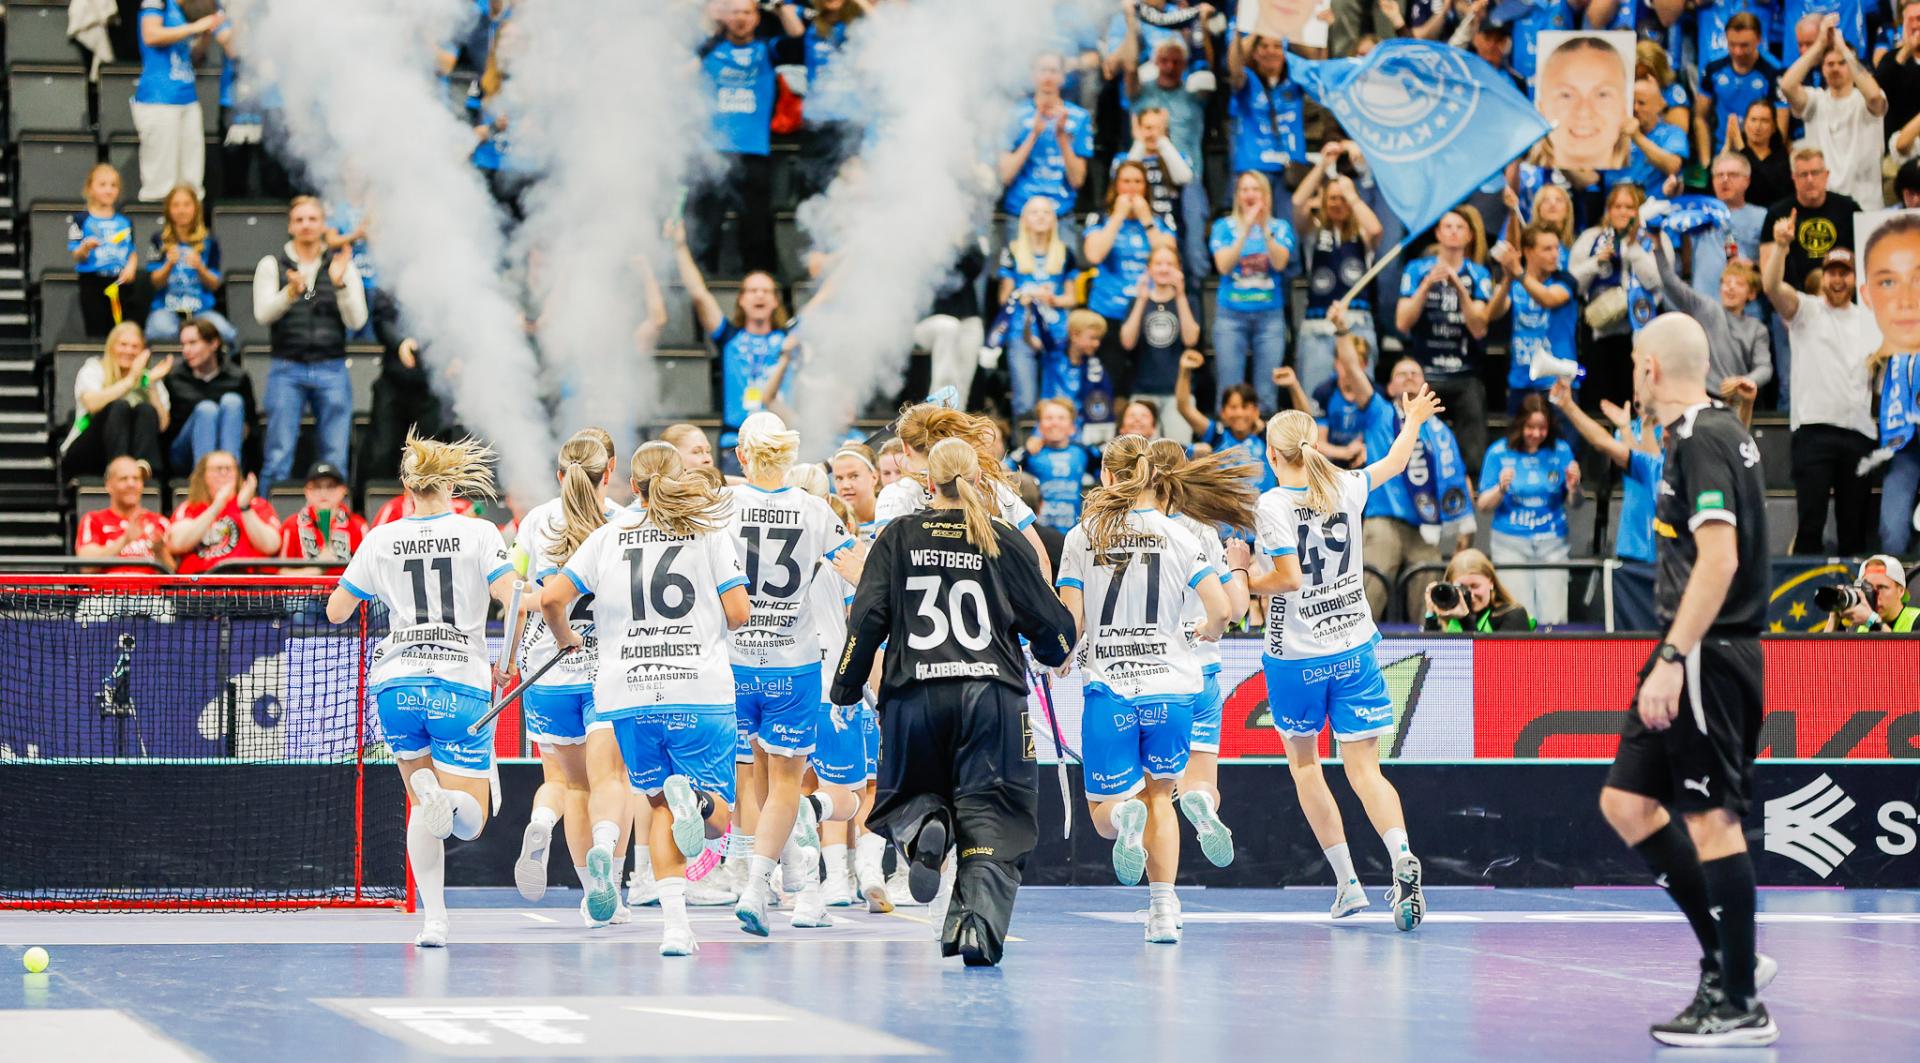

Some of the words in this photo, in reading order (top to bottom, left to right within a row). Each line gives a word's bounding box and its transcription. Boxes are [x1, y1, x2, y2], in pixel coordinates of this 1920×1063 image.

[741, 508, 800, 525] LIEBGOTT
[393, 537, 460, 555] SVARFVAR
[1297, 512, 1351, 586] 49
[740, 526, 803, 598] 13
[910, 549, 983, 571] WESTBERG
[403, 557, 455, 625] 11
[622, 545, 695, 621] 16
[1093, 552, 1160, 626] 71
[1302, 574, 1358, 599] UNIHOC
[750, 600, 800, 611] NIHOC
[906, 575, 992, 651] 30
[1299, 588, 1363, 621] KLUBBHUSE
[743, 613, 798, 628] BBHUSE
[1271, 593, 1287, 656] SKÅREBO
[392, 626, 469, 645] KLUBBHUSET
[627, 625, 693, 638] UNIHOC
[1099, 628, 1157, 638] UNIHOC
[621, 641, 702, 660] KLUBBHUSET
[735, 638, 796, 648] CALMARSUNDS
[1095, 641, 1167, 660] KLUBBHUSET
[401, 650, 469, 663] CALMARSUNDS
[627, 673, 698, 683] CALMARSUNDS
[916, 660, 1000, 680] KLUBBHUSET
[1302, 656, 1361, 682] Deurells
[628, 683, 646, 692] VVS
[656, 682, 665, 691] EL
[396, 691, 457, 712] Deurells
[773, 723, 786, 734] ICA
[1092, 772, 1106, 782] ICA
[1876, 801, 1920, 856] S
